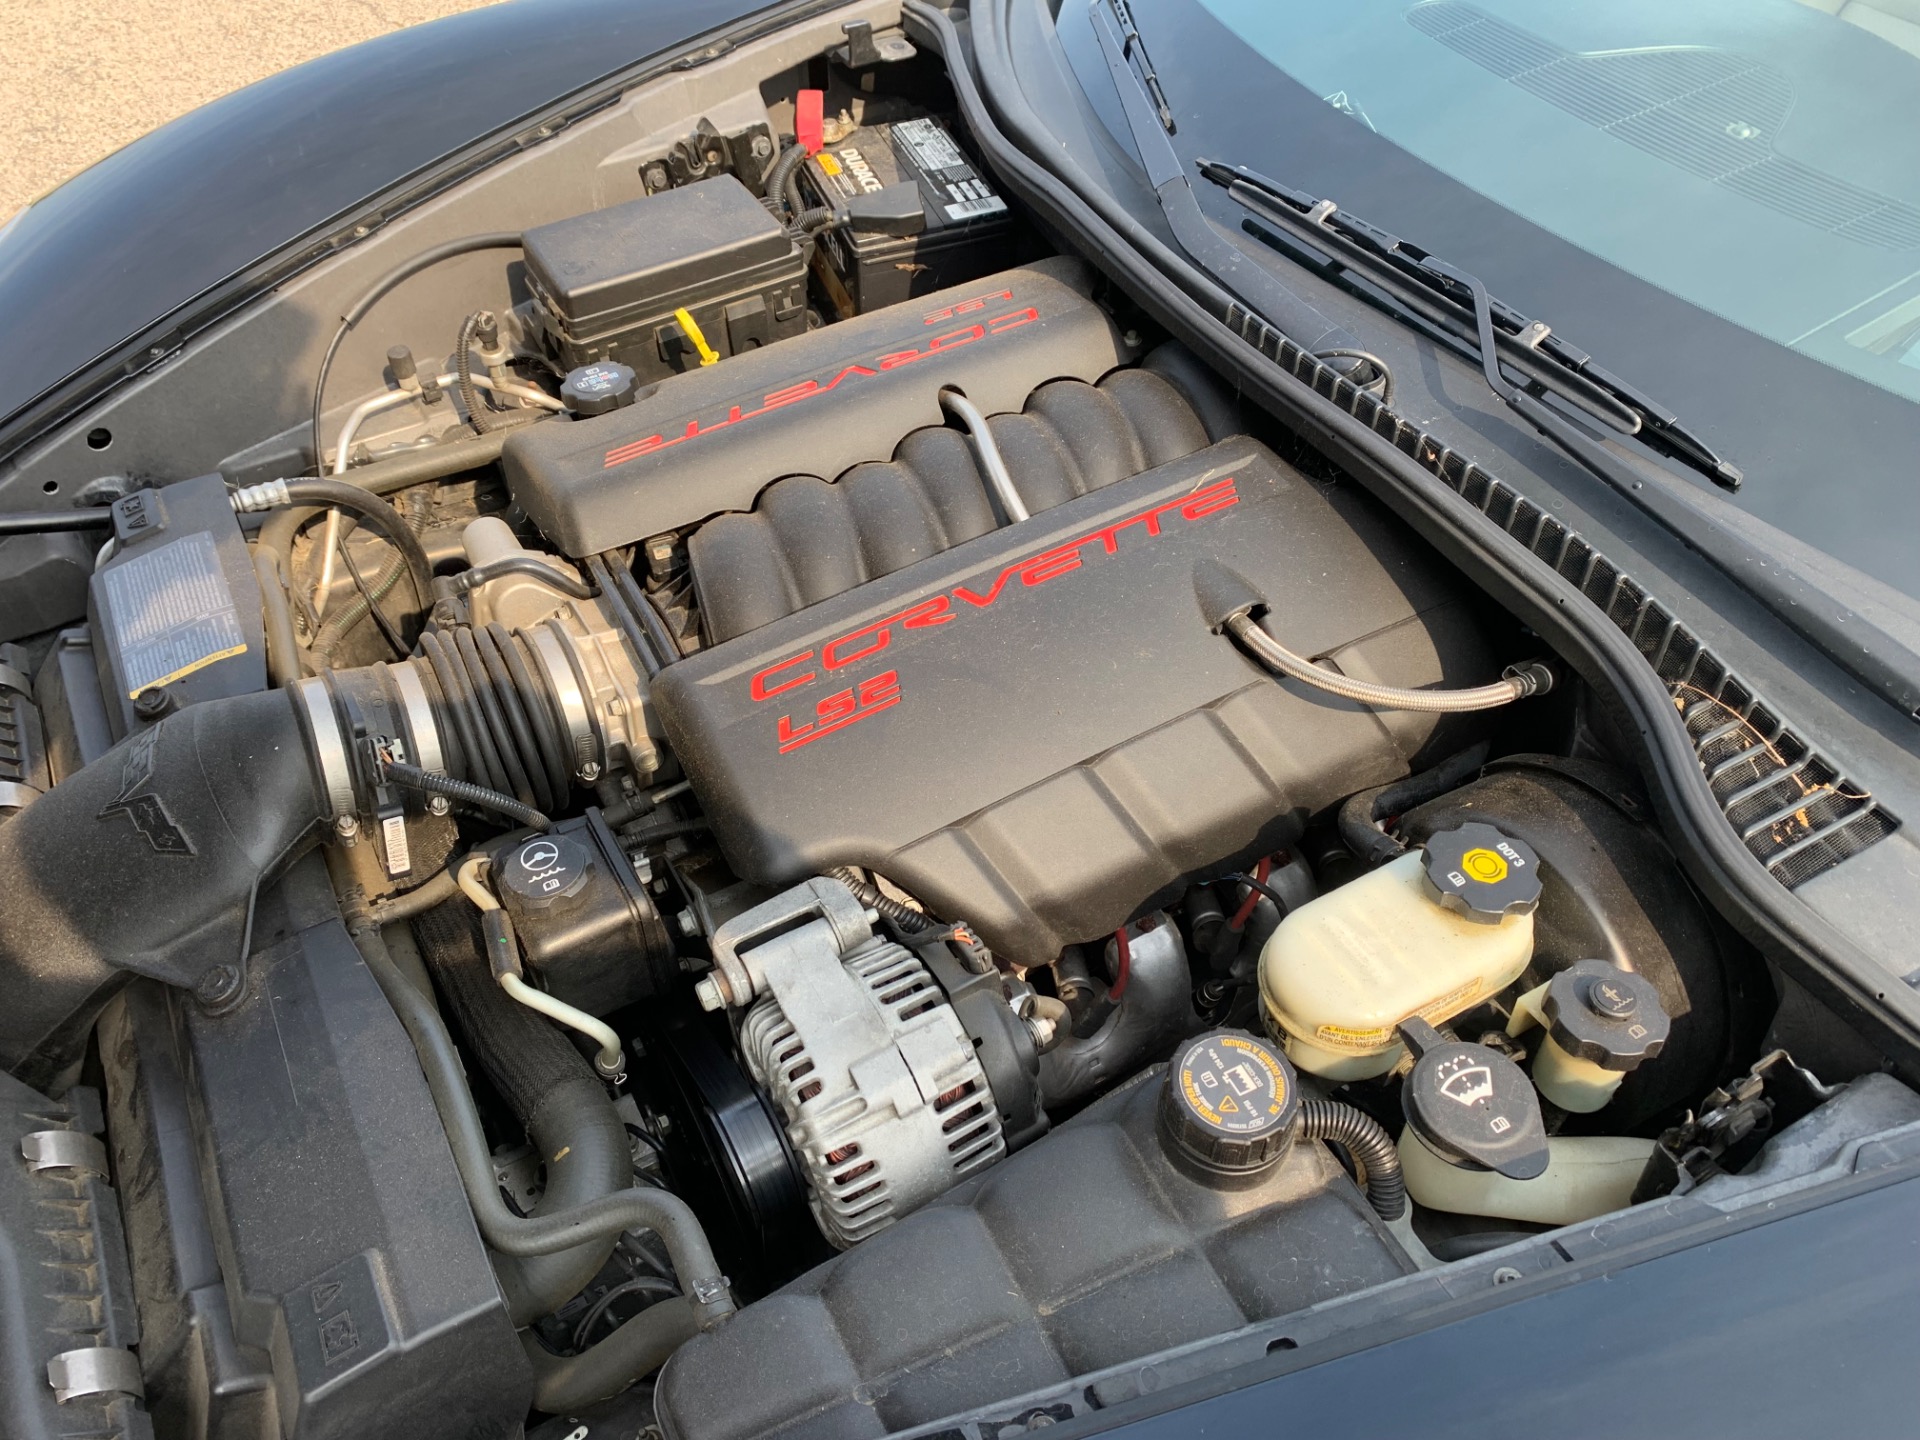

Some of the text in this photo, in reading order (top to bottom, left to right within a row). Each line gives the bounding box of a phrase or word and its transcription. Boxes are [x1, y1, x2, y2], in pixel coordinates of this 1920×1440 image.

[839, 148, 884, 193] DURACE
[923, 290, 1014, 325] LS2
[604, 307, 1039, 469] CORVETTE
[749, 477, 1240, 702] CORVETTE
[778, 669, 901, 745] LS2
[1496, 842, 1526, 868] DOT 3
[1257, 1049, 1282, 1075] OUVRIR
[1184, 1087, 1202, 1107] OPEN
[1275, 1076, 1286, 1105] JAMAIS
[1197, 1104, 1222, 1124] NEVER
[1268, 1104, 1280, 1115] NE
